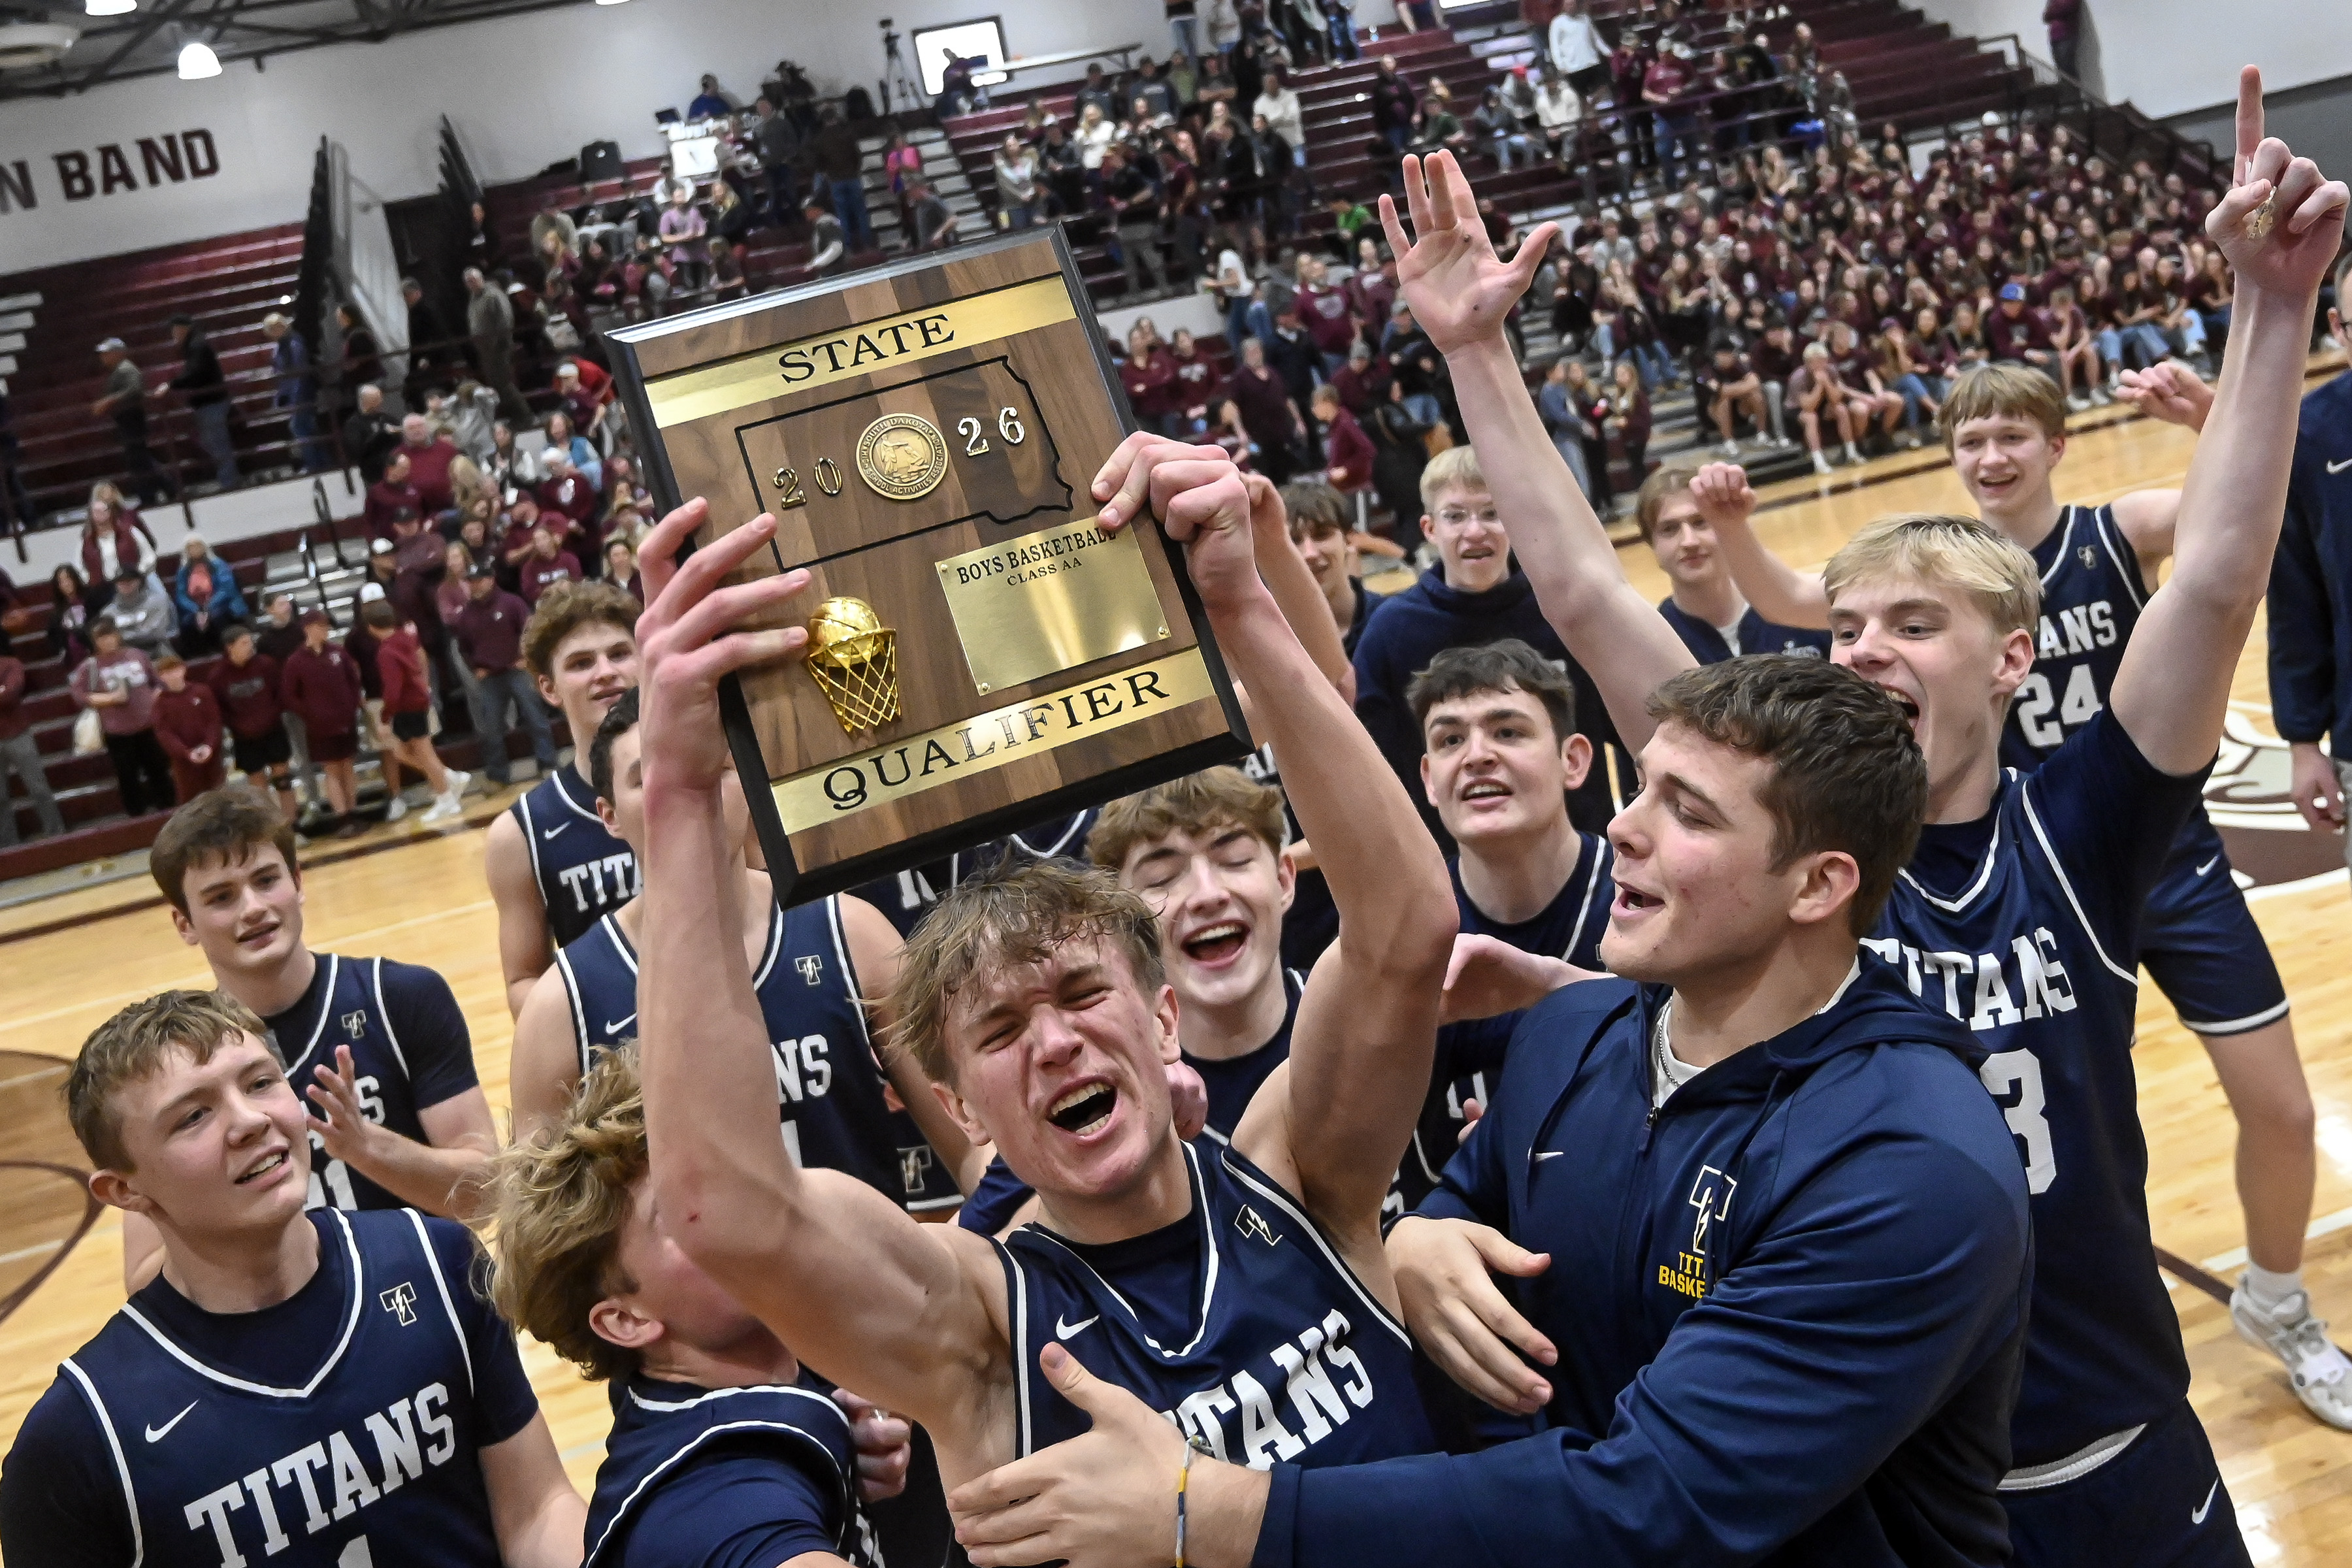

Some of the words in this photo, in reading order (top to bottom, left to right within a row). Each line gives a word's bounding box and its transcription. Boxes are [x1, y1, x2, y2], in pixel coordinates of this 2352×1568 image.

[52, 128, 220, 202] BAND
[777, 313, 956, 384] STATE
[864, 421, 888, 446] SOUTH
[889, 417, 930, 433] DAKOTA
[866, 468, 890, 491] SCHOOL
[892, 478, 932, 494] ACTIVITIES
[956, 555, 1004, 585] BOYS
[1006, 527, 1117, 570] BASKETBALL
[1007, 564, 1057, 586] CLASS
[1062, 557, 1083, 571] AA
[2037, 600, 2117, 659] ANS
[2014, 664, 2103, 747] 24
[823, 670, 1170, 811] QUALIFIER
[559, 851, 643, 913] TIT
[1979, 1047, 2057, 1195] 3
[1658, 1265, 1706, 1299] BASKE
[1679, 1251, 1706, 1279] TIT
[1162, 1308, 1373, 1471] TANS
[184, 1382, 456, 1568] TITANS
